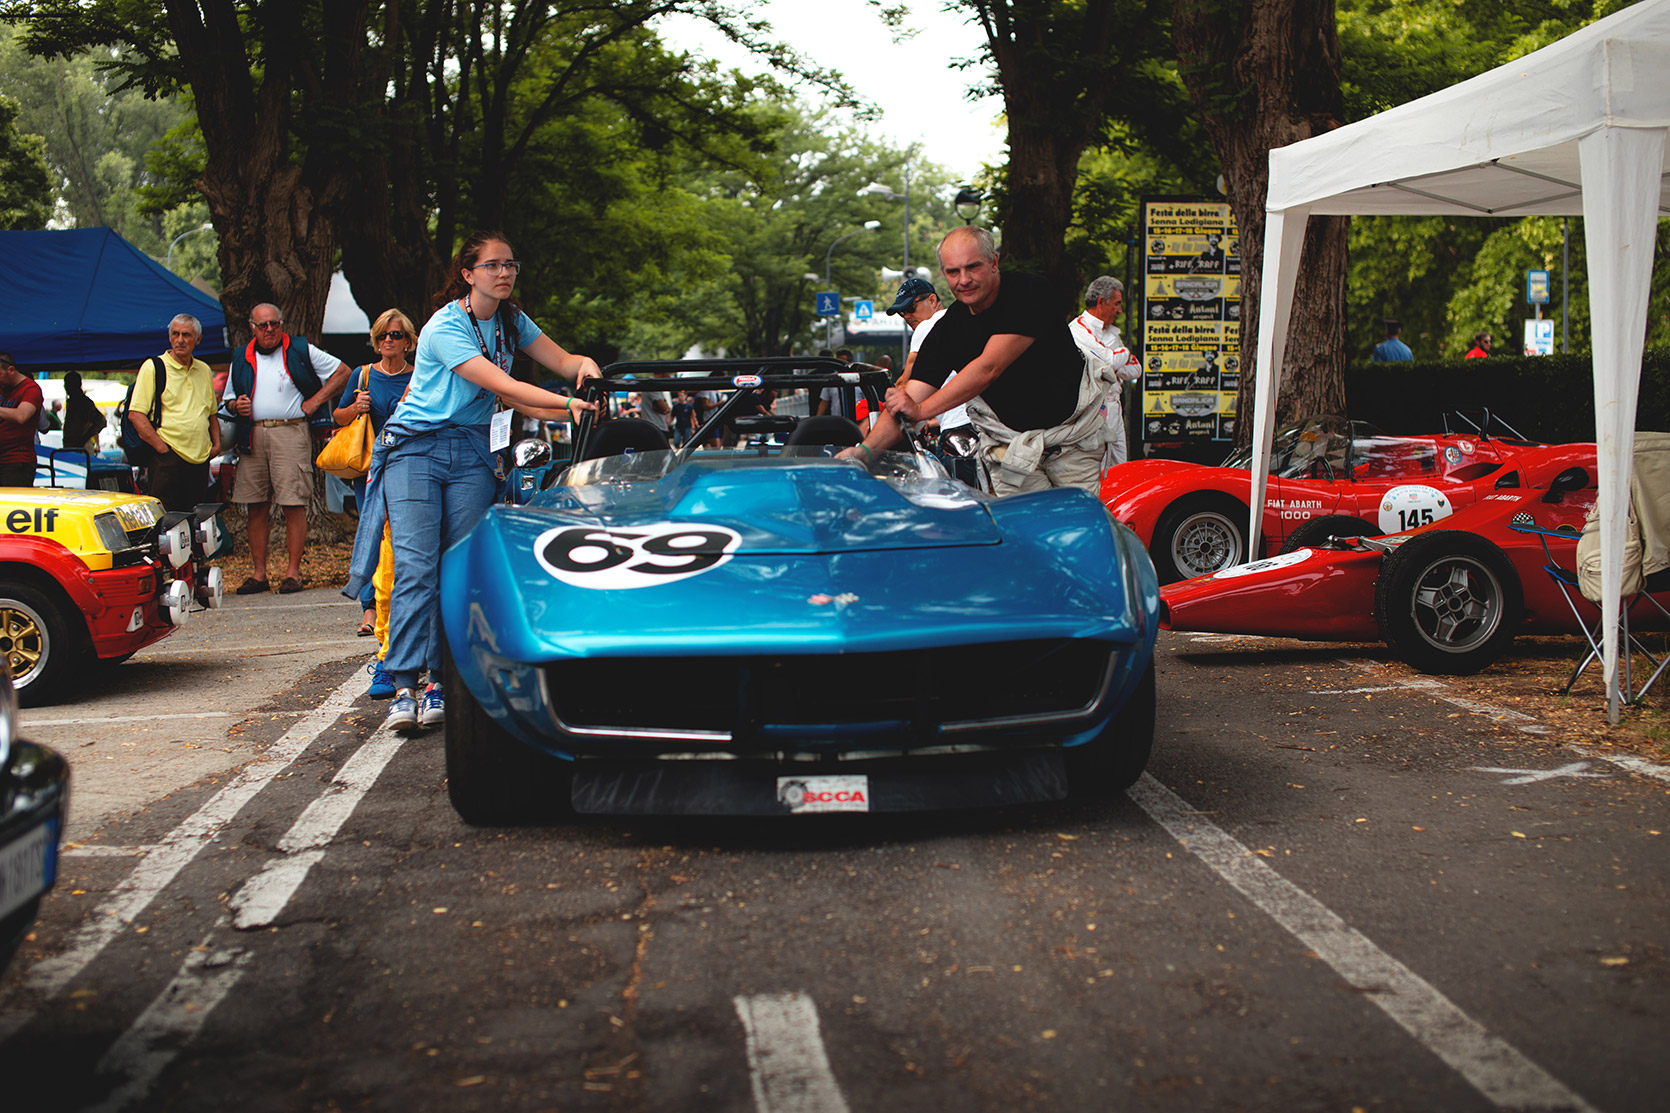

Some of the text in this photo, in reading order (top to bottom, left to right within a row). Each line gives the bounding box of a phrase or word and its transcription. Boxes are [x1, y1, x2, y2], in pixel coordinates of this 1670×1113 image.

[1175, 208, 1197, 216] della
[1198, 208, 1219, 216] birra
[1179, 218, 1224, 226] Lodigiana
[1172, 325, 1193, 333] della
[1194, 325, 1215, 333] birra
[1176, 335, 1220, 343] Lodigiana
[1267, 500, 1322, 509] FIAT ABARTH
[1280, 510, 1311, 520] 1000
[1397, 508, 1435, 531] 145
[6, 507, 59, 533] elf
[542, 528, 734, 575] 69
[802, 791, 866, 804] SCCA
